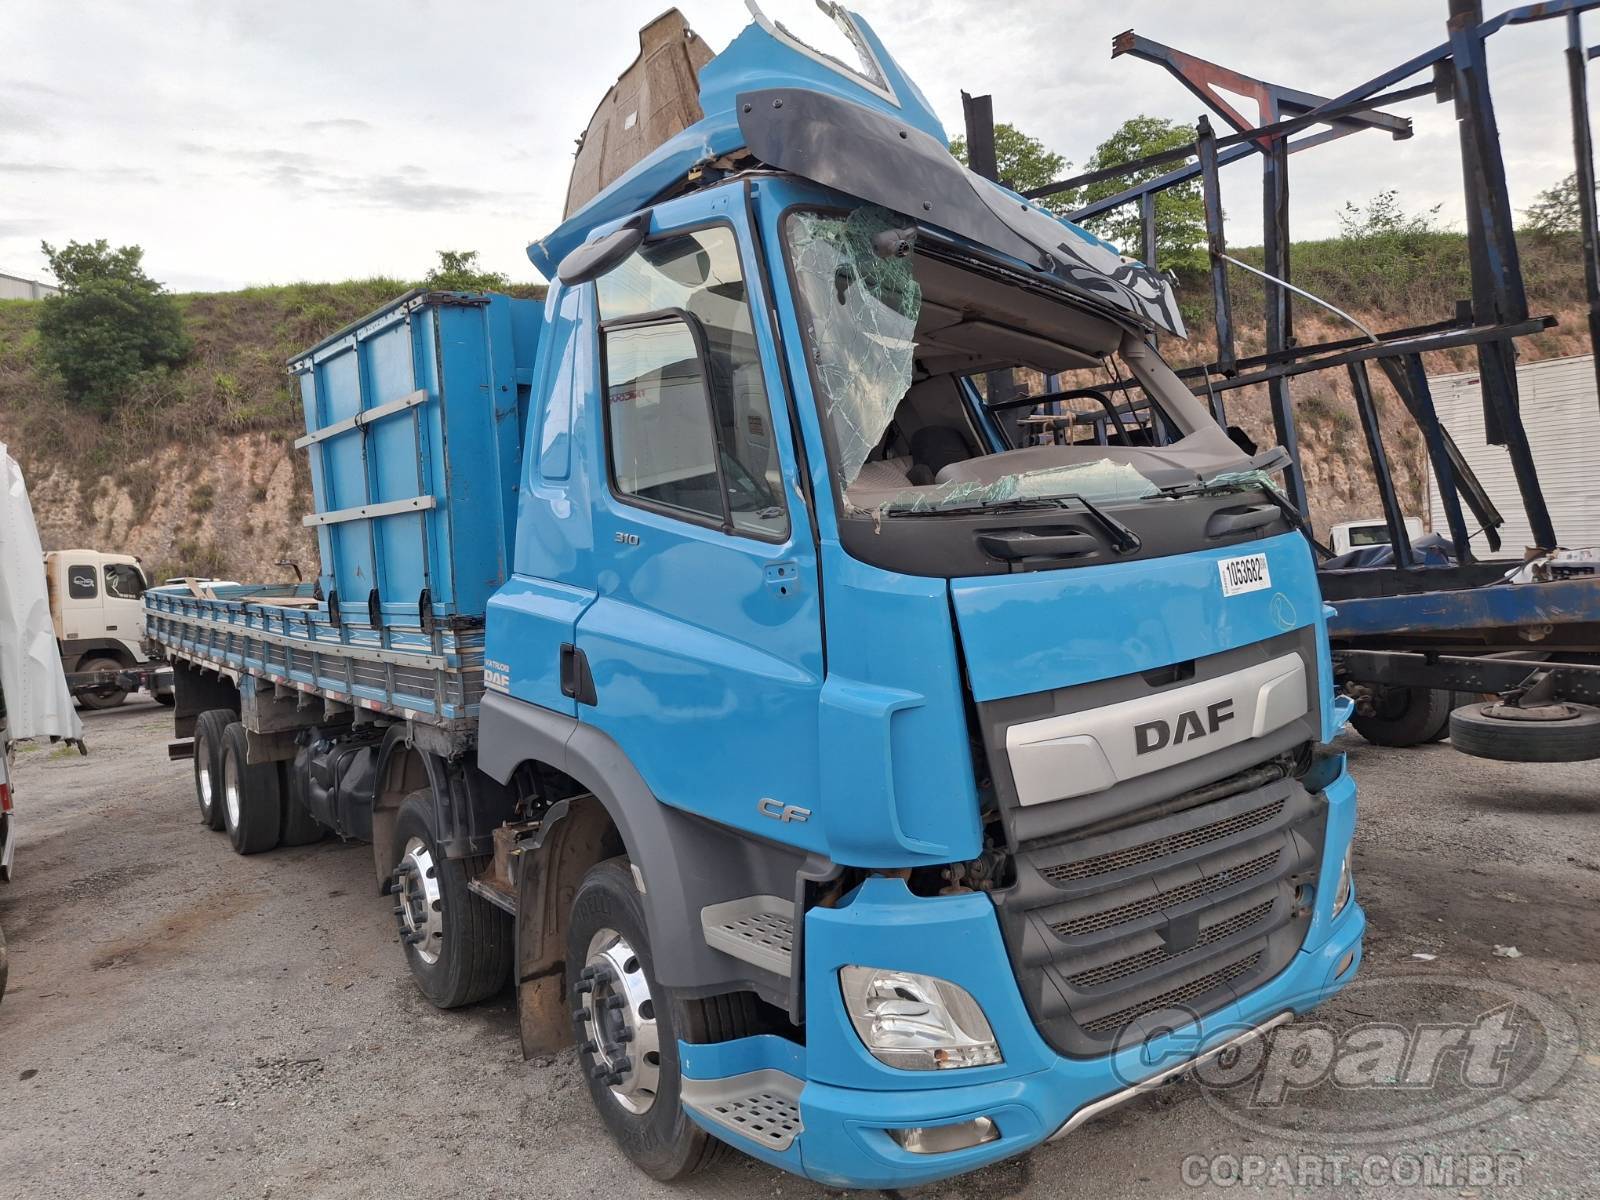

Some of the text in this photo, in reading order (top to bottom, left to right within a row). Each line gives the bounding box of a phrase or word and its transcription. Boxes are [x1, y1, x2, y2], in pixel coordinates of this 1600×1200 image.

[615, 531, 640, 546] 310
[1226, 557, 1263, 587] 1053682
[484, 669, 510, 686] DAF
[1133, 698, 1234, 756] DAF
[757, 797, 813, 823] CF
